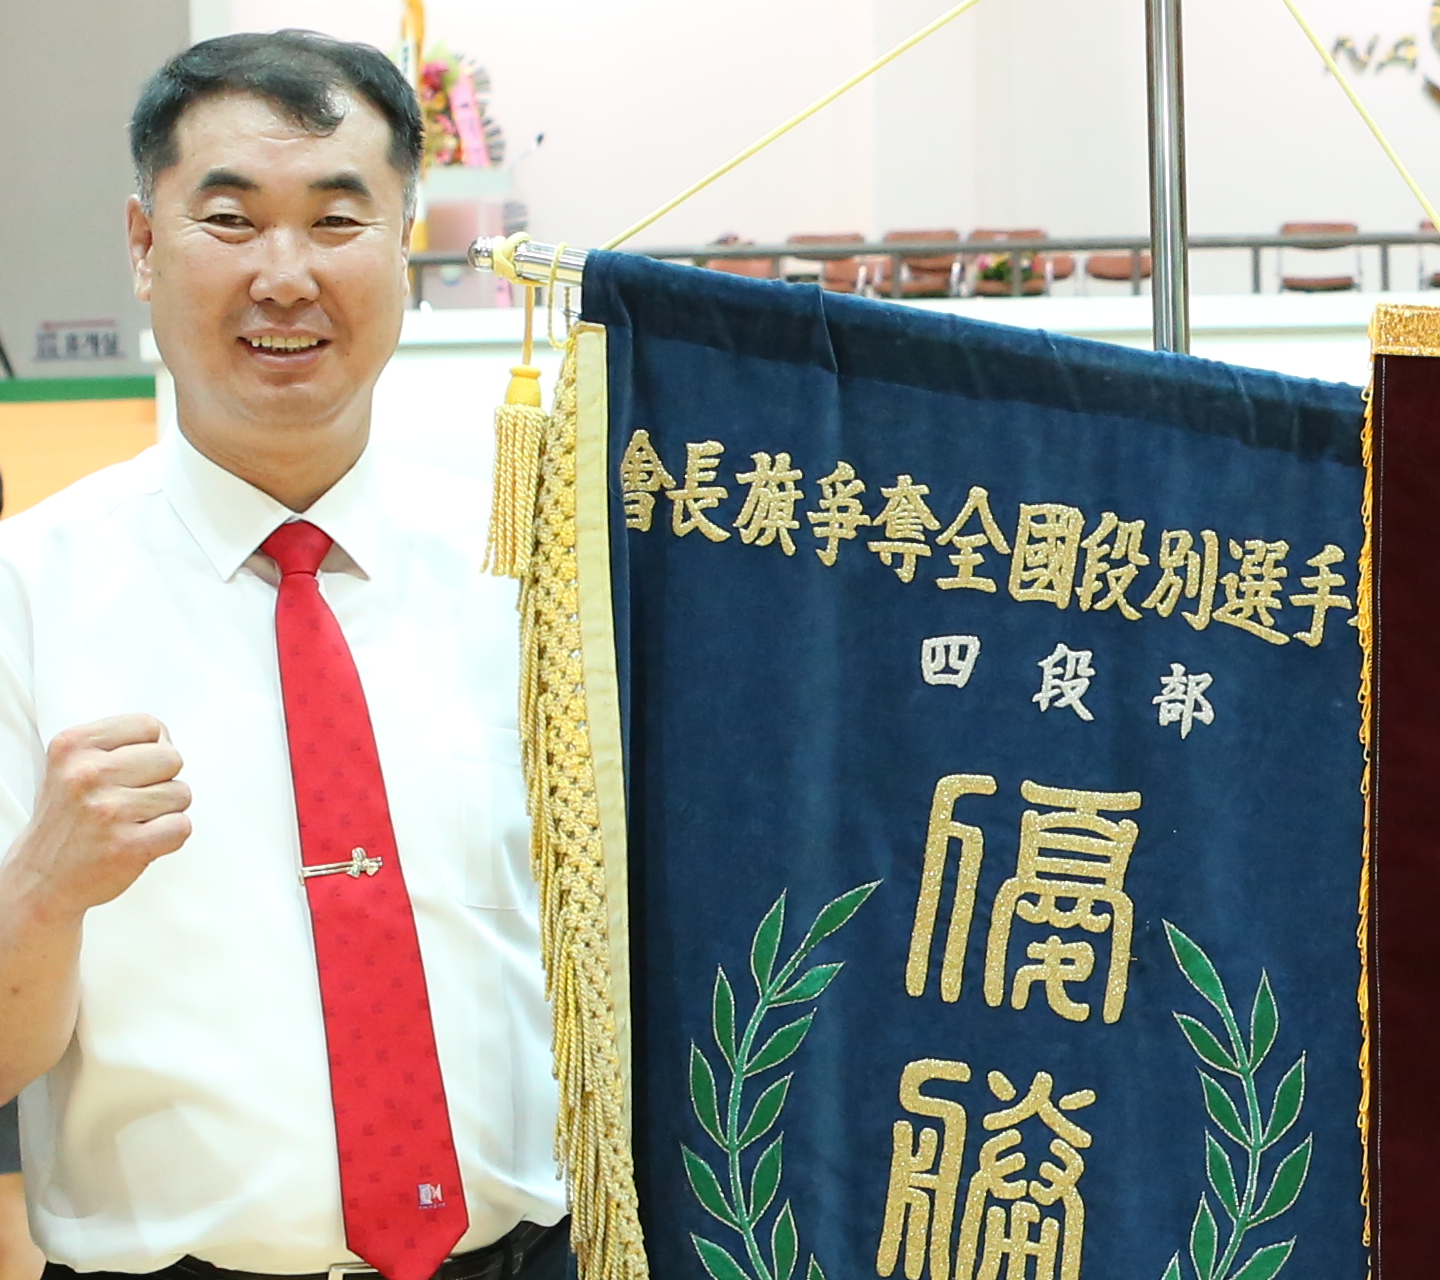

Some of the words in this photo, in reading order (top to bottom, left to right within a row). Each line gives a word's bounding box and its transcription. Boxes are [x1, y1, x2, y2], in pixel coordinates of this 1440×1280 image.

[620, 428, 1359, 648] 會長旗爭奪全國段別選手
